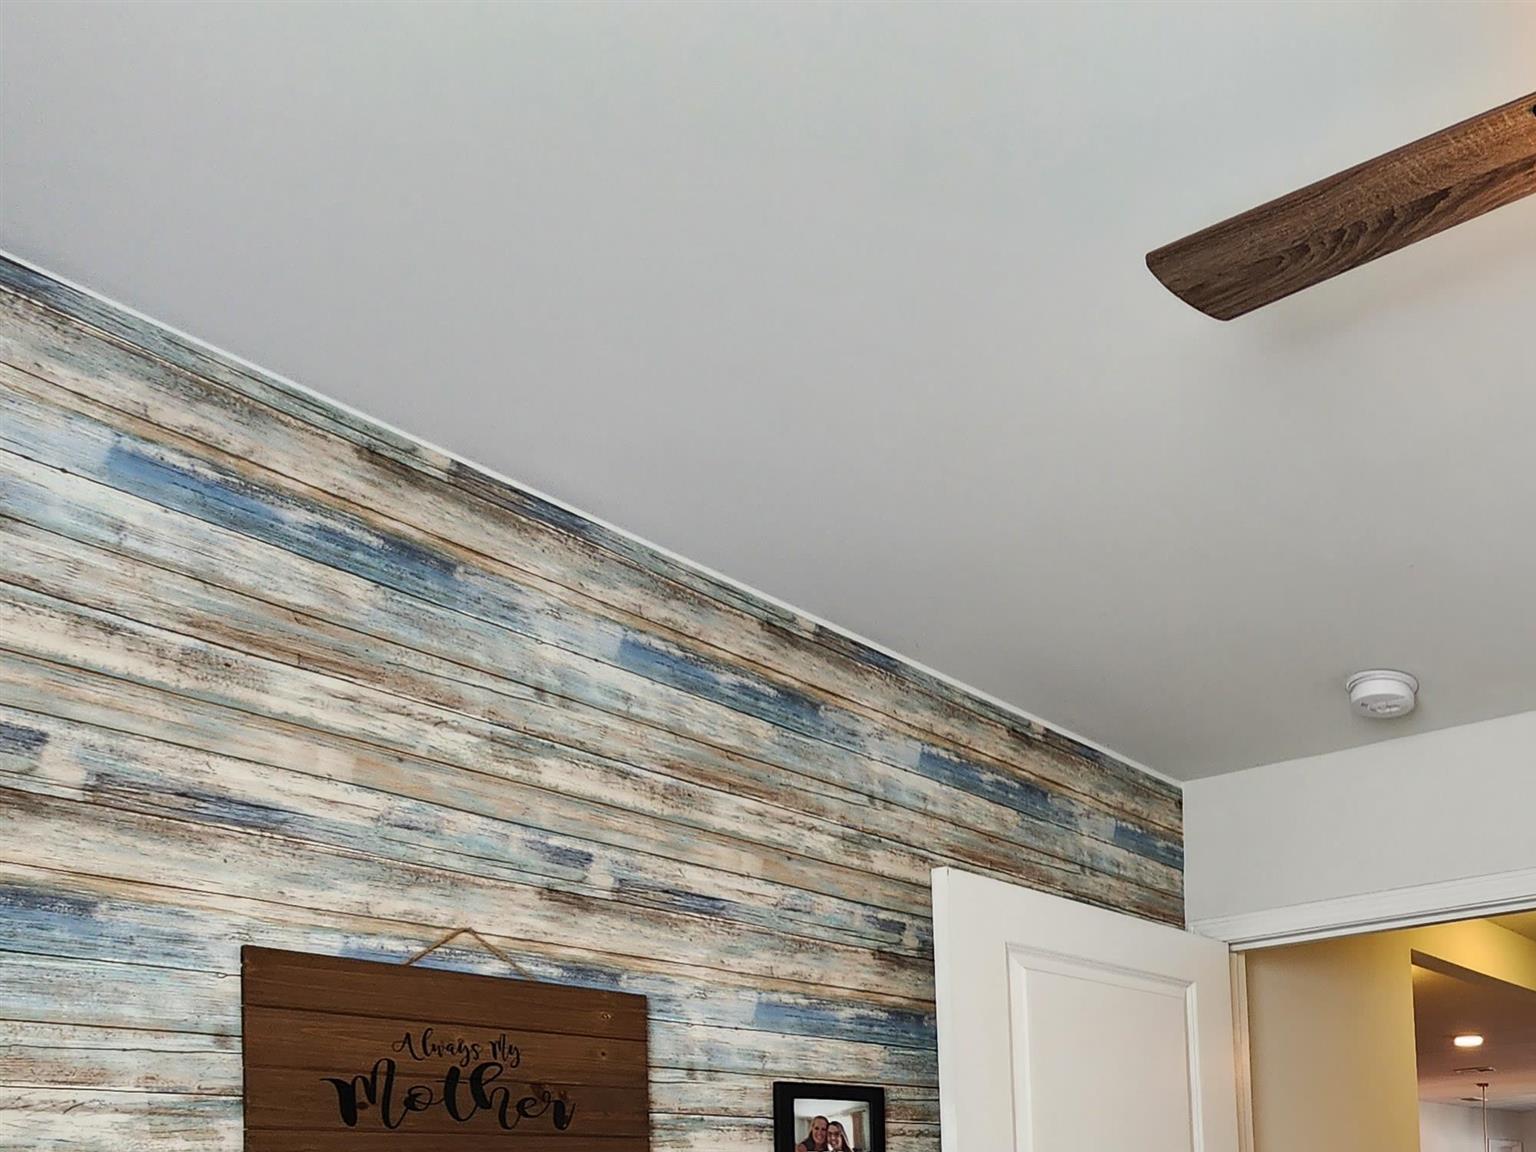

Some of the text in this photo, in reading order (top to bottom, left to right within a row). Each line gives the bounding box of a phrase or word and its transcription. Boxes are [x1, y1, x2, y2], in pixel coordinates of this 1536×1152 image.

[391, 1028, 521, 1068] Always My
[320, 1057, 576, 1130] Mother
